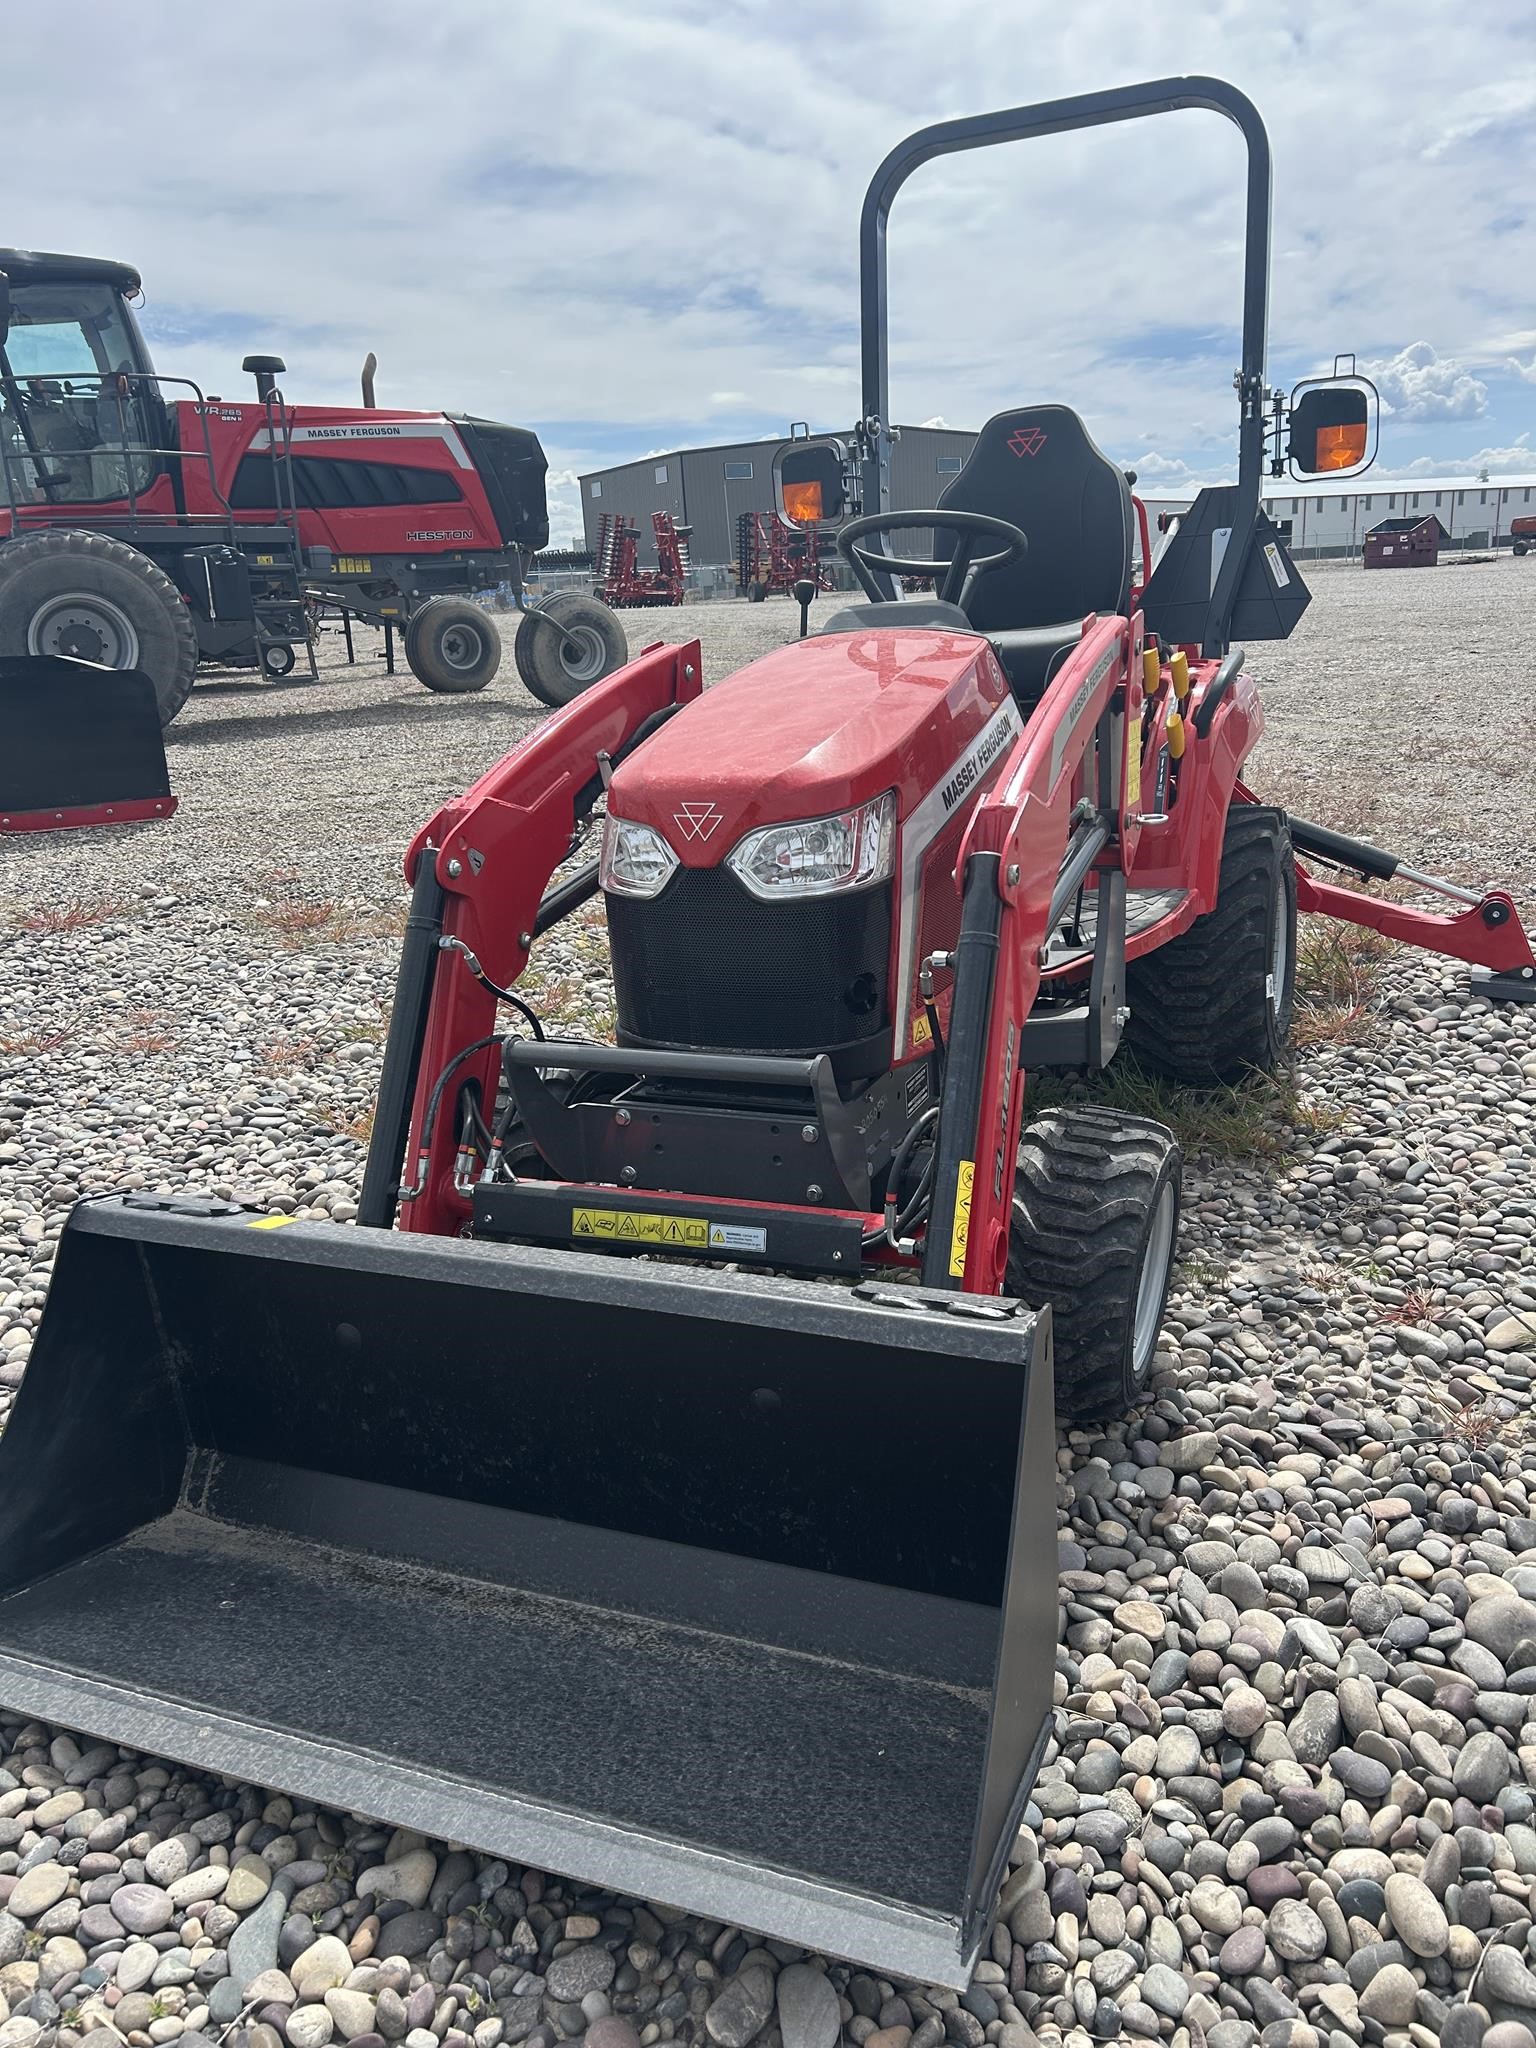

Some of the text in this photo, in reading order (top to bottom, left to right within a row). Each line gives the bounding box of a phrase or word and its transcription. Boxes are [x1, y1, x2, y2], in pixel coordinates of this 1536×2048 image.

[307, 427, 400, 438] MASSEY FERGUSON
[406, 530, 473, 541] HESSTON
[941, 756, 979, 811] MASSEY
[977, 713, 1012, 769] FERGUSON
